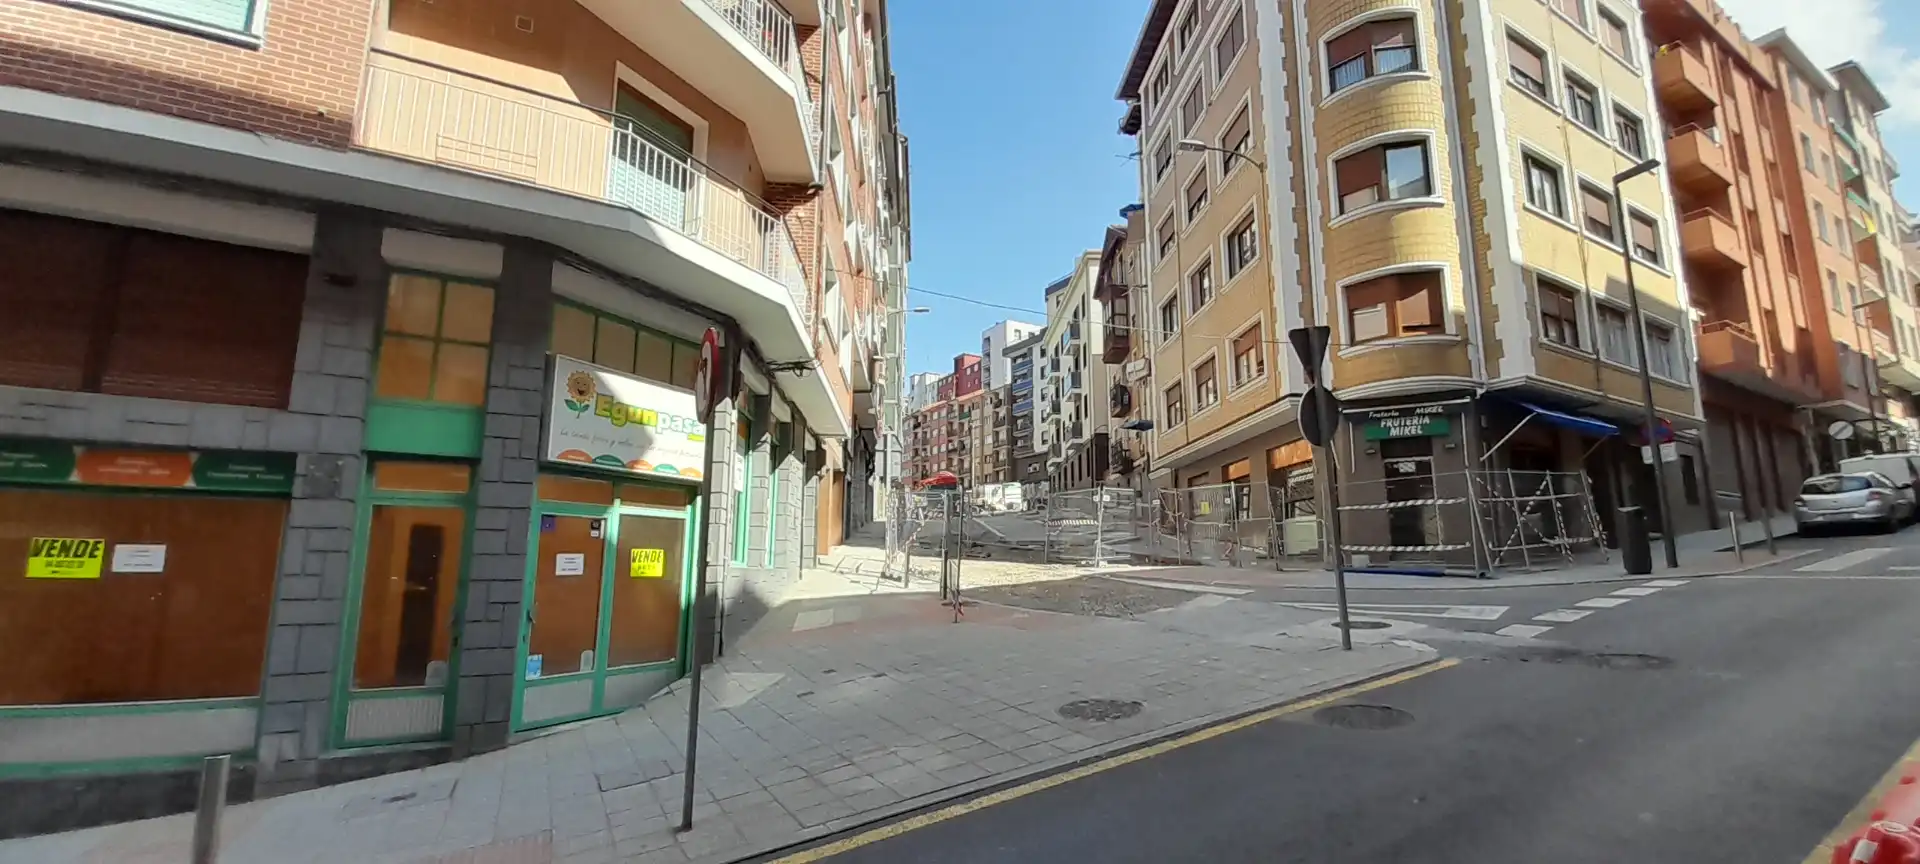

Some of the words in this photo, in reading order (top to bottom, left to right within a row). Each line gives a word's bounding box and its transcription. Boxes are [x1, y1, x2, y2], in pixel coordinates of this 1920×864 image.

[1389, 425, 1423, 437] MIKEL
[30, 538, 103, 559] VENDE
[632, 550, 662, 563] VENDE
